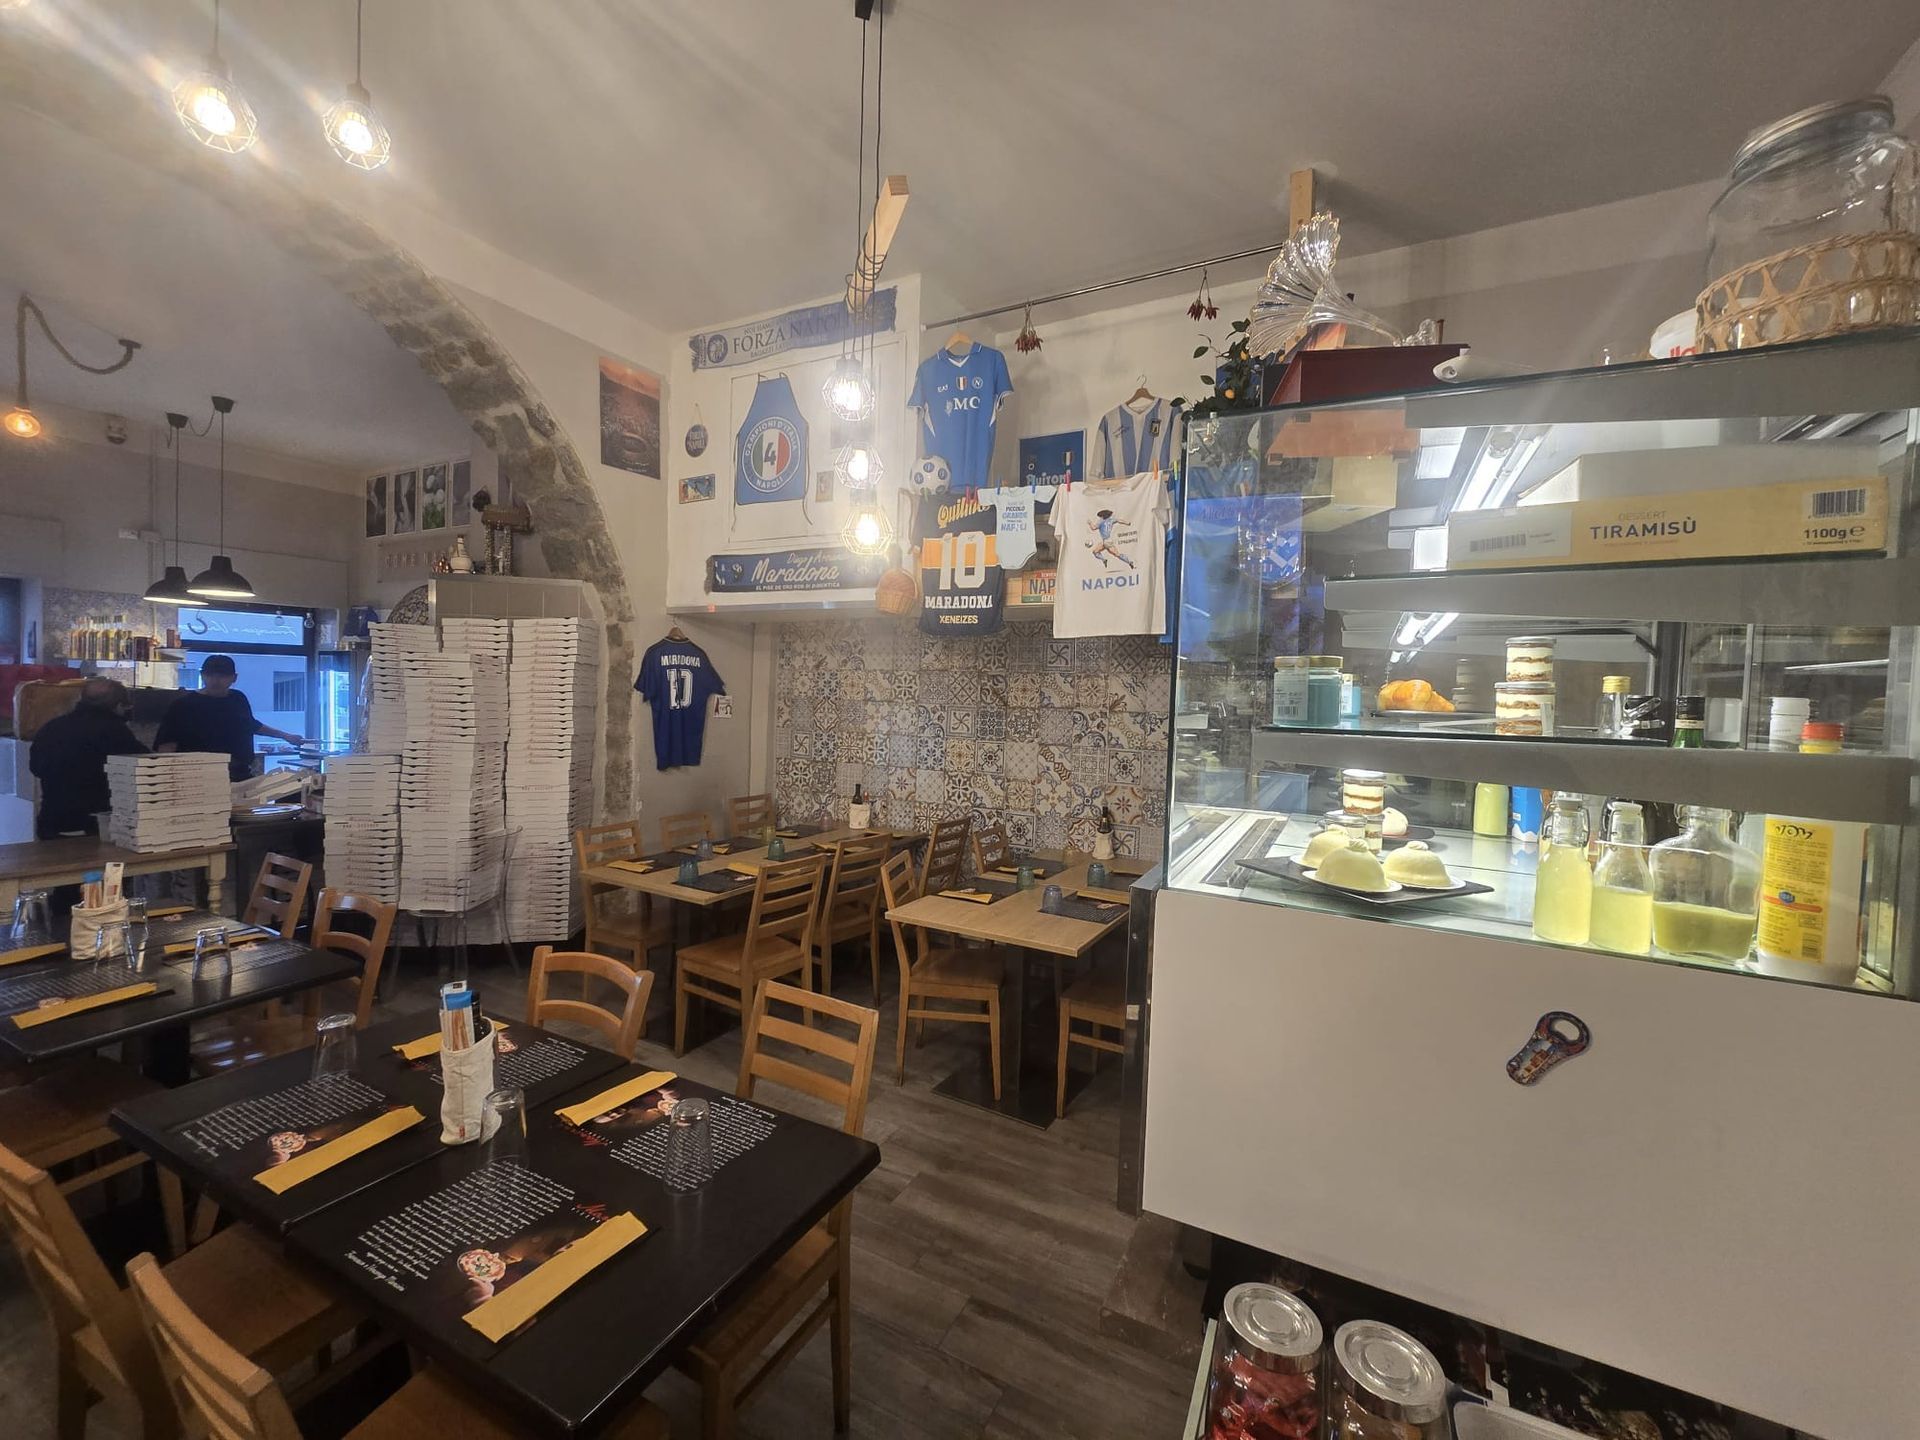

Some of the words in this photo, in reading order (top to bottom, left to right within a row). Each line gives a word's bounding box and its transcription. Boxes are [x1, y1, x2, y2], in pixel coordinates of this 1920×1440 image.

[733, 329, 786, 354] FORZA
[745, 421, 777, 456] CAMPIONI
[763, 442, 777, 466] 4
[755, 476, 783, 489] NAPOLI
[1618, 510, 1666, 521] DESSERT
[1589, 516, 1697, 540] TIRAMISÙ
[1804, 527, 1847, 540] 1100g
[750, 557, 840, 583] Maradona
[939, 531, 985, 590] 10
[1082, 574, 1140, 591] NAPOLI
[924, 594, 993, 610] MARADONA
[939, 614, 979, 625] XENEIZES
[666, 668, 693, 711] 10
